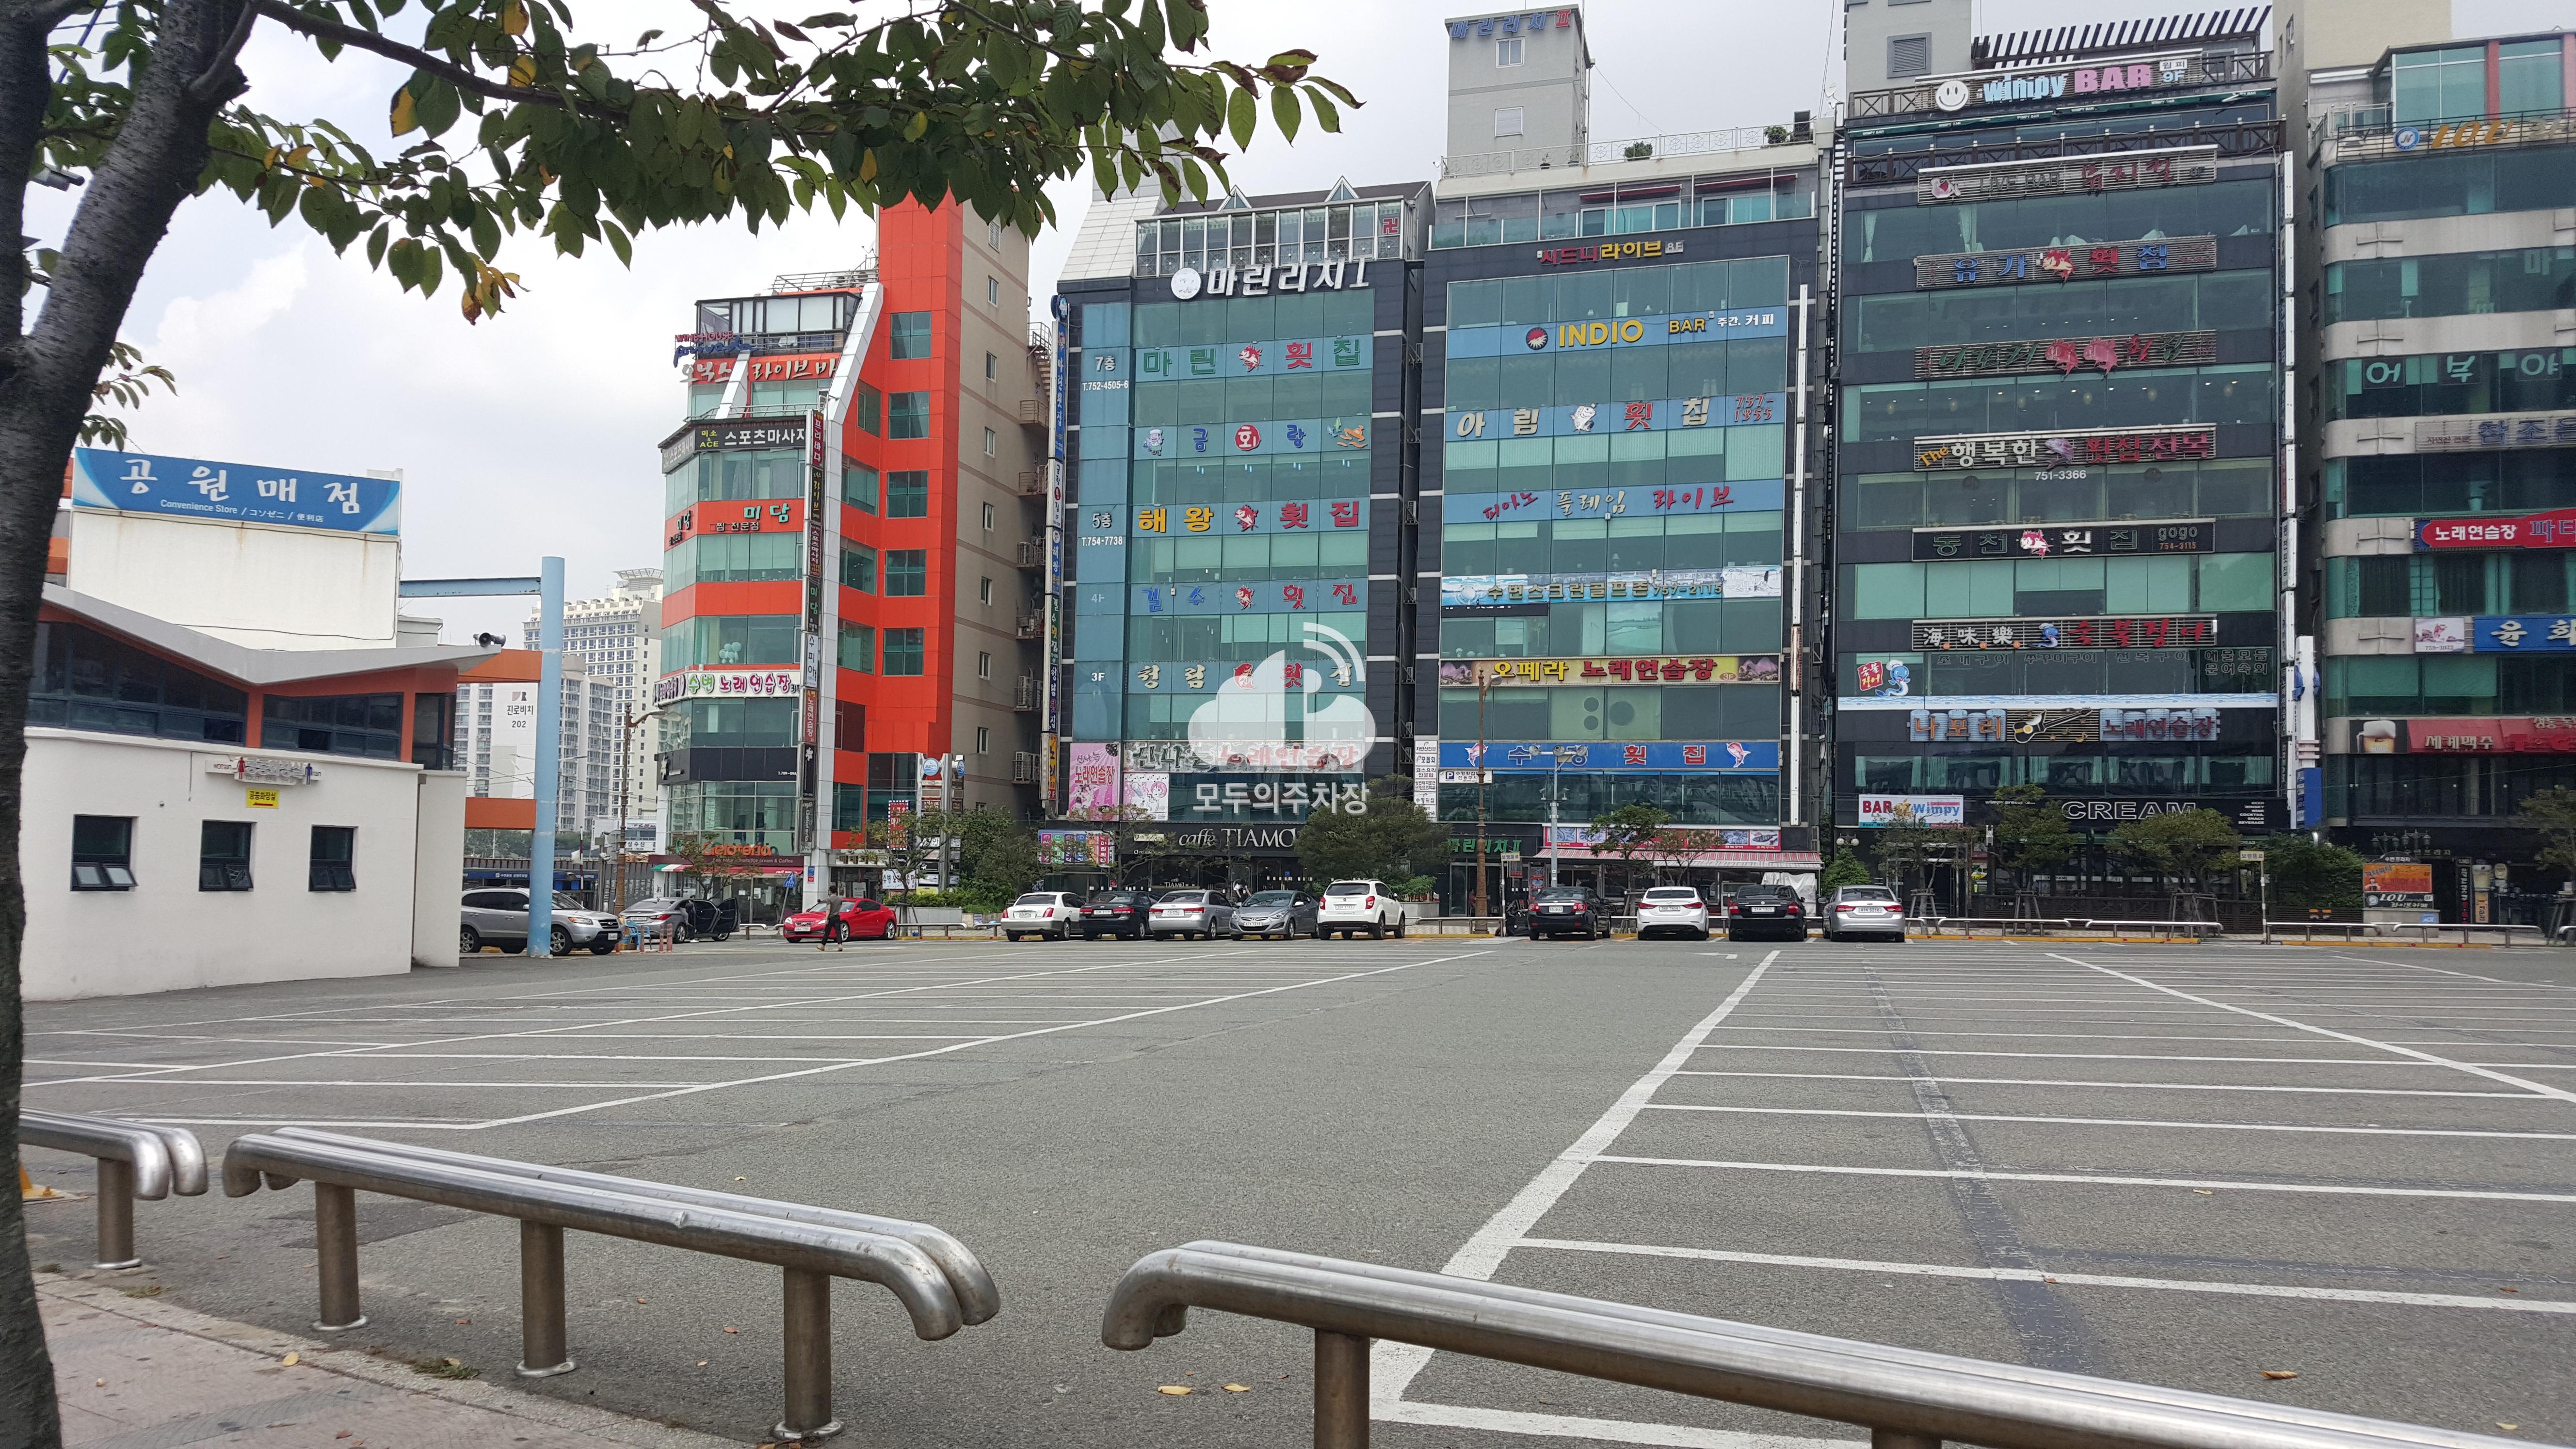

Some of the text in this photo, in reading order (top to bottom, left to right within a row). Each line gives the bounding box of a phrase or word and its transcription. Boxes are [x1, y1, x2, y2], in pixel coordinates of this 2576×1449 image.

[1983, 64, 2151, 102] wimpy BAR
[2163, 72, 2184, 82] 9F
[1980, 172, 2061, 193] LIVE BAR
[1601, 240, 1662, 260] 라이브
[1666, 242, 1683, 253] 8F
[1952, 254, 2028, 283] 유가
[2089, 244, 2168, 274] 횟집
[1744, 313, 1774, 326] 커피
[1559, 318, 1706, 348] INDIO BAR
[1095, 355, 1115, 371] 7층
[1143, 338, 1360, 376] 마린 횟집
[1082, 380, 1129, 392] T.752-4505-6
[1457, 397, 1710, 437] 아림 횟집
[1918, 445, 1948, 468] The
[1950, 438, 2039, 467] 행복한
[2035, 469, 2086, 481] 751-3366
[119, 459, 361, 514] 공원매점
[161, 499, 213, 513] Convenience
[215, 504, 238, 515] Store
[1483, 486, 1734, 519] 피아노 플레임 라이브
[743, 503, 791, 523] 미당
[1092, 513, 1113, 529] 5층
[1138, 501, 1359, 533] 해왕 횟집
[716, 521, 759, 531] 찜 전문점
[2158, 526, 2197, 541] gogo
[2435, 525, 2516, 541] 노래연습장
[1081, 536, 1123, 547] T.754-7738
[1932, 529, 2138, 557] 동천 횟집
[810, 587, 818, 614] 미당
[1142, 583, 1357, 613] 길수 횟집
[1487, 581, 1722, 601] 수변스크린골프존 757-2115
[1091, 672, 1105, 681] 3F
[1493, 658, 1718, 681] 오페라 노래연습장
[688, 673, 715, 694] 수변
[719, 672, 791, 694] 노래연습장
[512, 720, 527, 728] 202
[1915, 716, 2002, 740] 나포리
[2103, 716, 2215, 738] 노래연습장
[2425, 735, 2495, 750] 세계맥주
[1075, 765, 1115, 785] 노래연습장
[250, 791, 275, 801] 공중화장실
[1863, 801, 1892, 813] BAR
[2061, 801, 2196, 820] CREAM
[1217, 827, 1297, 848] TIAMO
[703, 841, 772, 856] Gelateria
